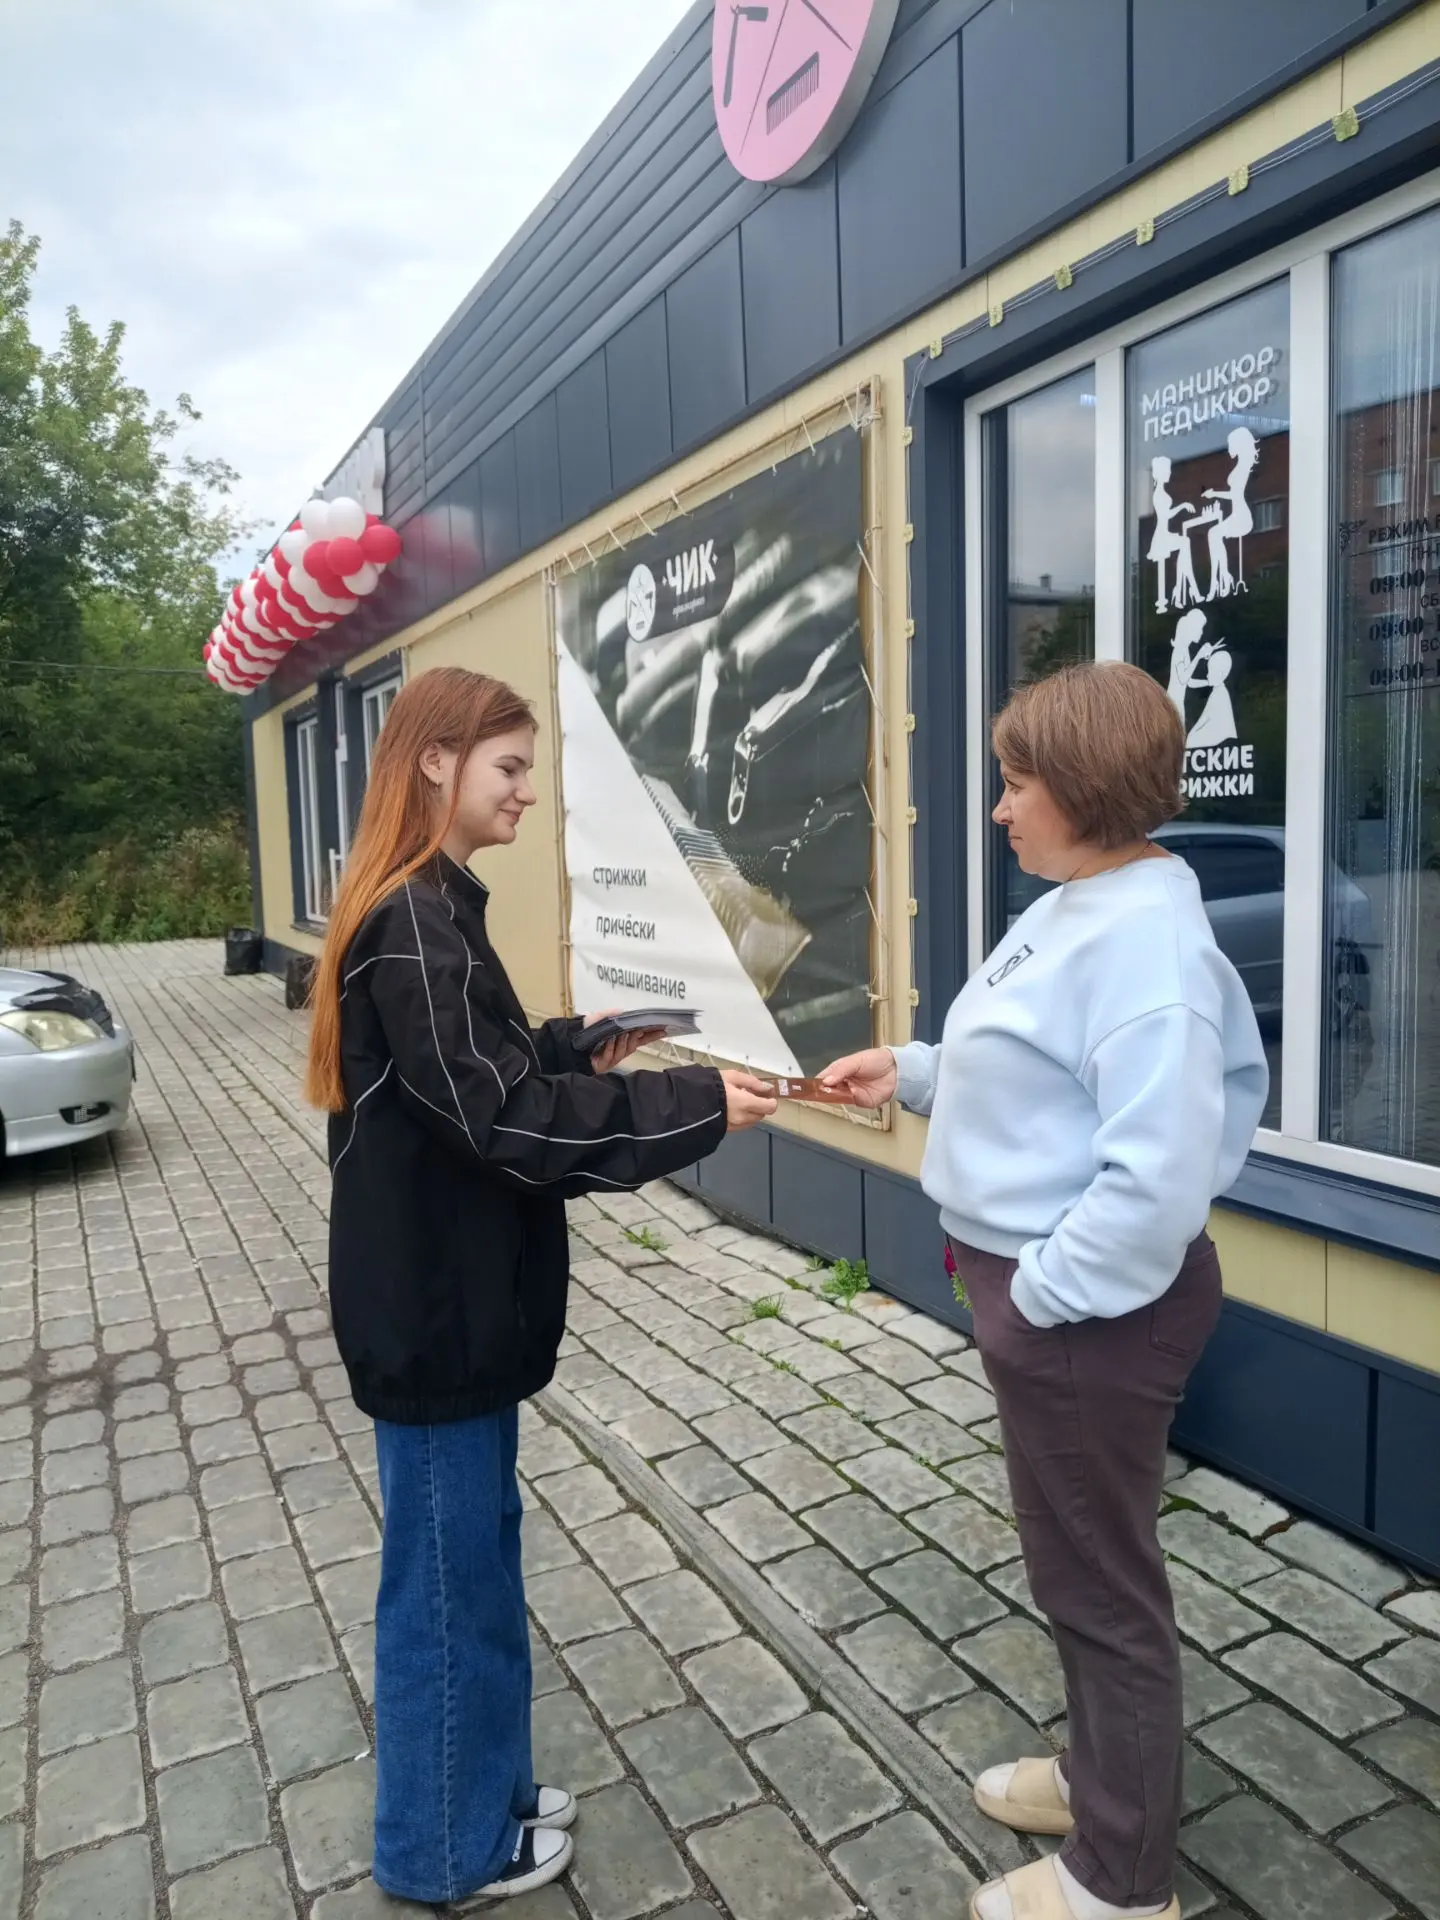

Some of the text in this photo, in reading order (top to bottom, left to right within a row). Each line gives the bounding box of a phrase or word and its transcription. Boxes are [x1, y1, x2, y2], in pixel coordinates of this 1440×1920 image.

[1142, 346, 1274, 416] МАНИКЮР
[1144, 376, 1270, 442] ПЕДИКЮР
[1368, 517, 1429, 544] РЕЖИМ
[1182, 744, 1254, 773] ТСКИЕ
[1179, 773, 1254, 798] РИЖКИ
[593, 866, 647, 890] стрижки
[596, 913, 656, 941] причёски
[596, 963, 686, 1000] окрашивание
